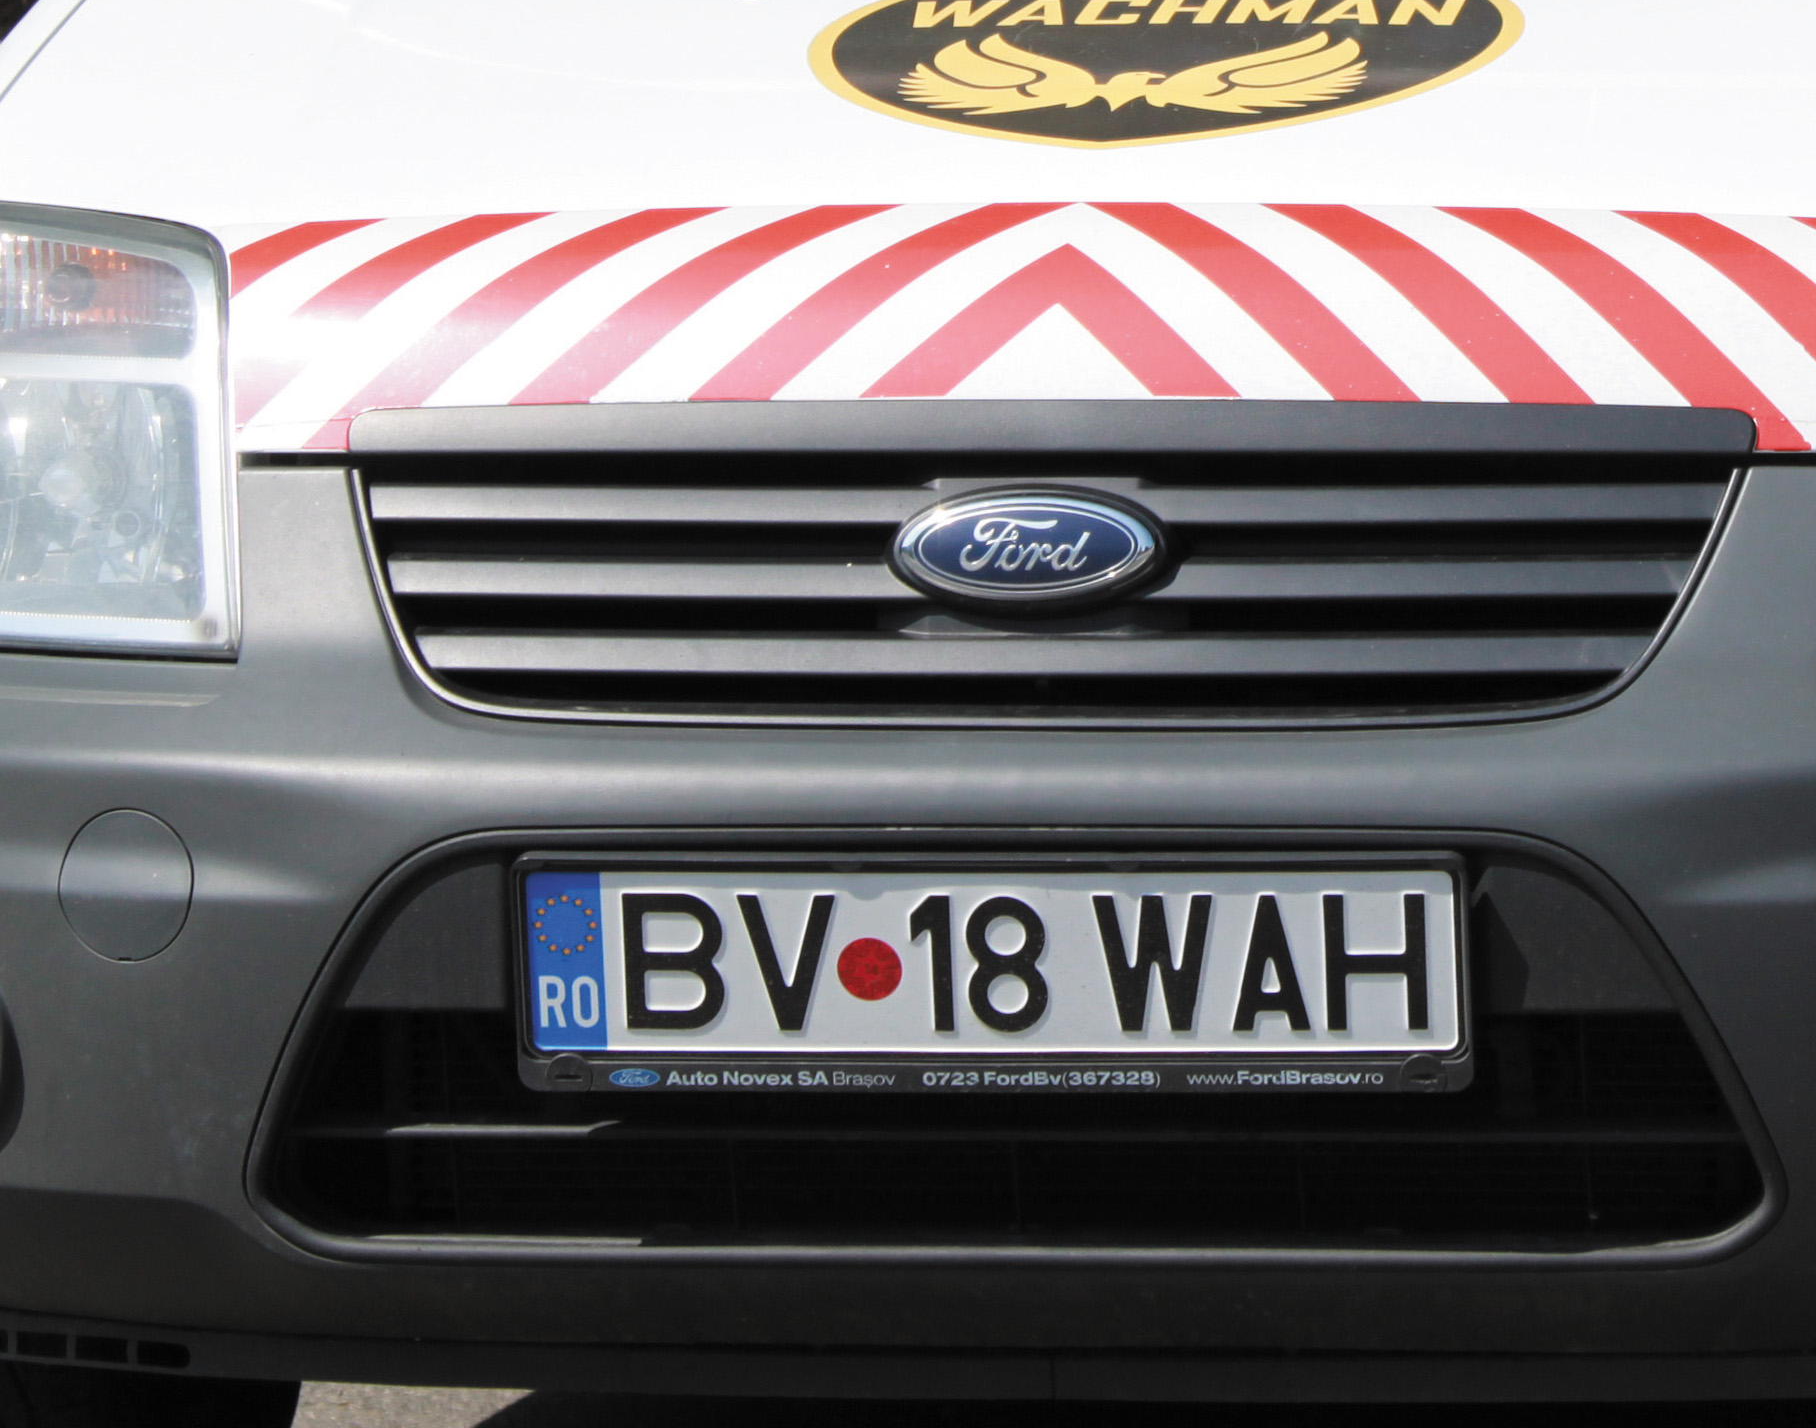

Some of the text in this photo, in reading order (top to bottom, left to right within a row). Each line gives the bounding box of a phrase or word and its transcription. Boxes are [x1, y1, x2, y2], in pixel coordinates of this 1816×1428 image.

[959, 517, 1091, 572] Ford
[621, 892, 1429, 1033] BV 18 WAH
[539, 975, 599, 1028] RO
[666, 1070, 718, 1086] Auto
[722, 1071, 793, 1086] Novex
[798, 1071, 828, 1086] SA
[833, 1071, 896, 1089] Brașov
[923, 1071, 979, 1086] 0723
